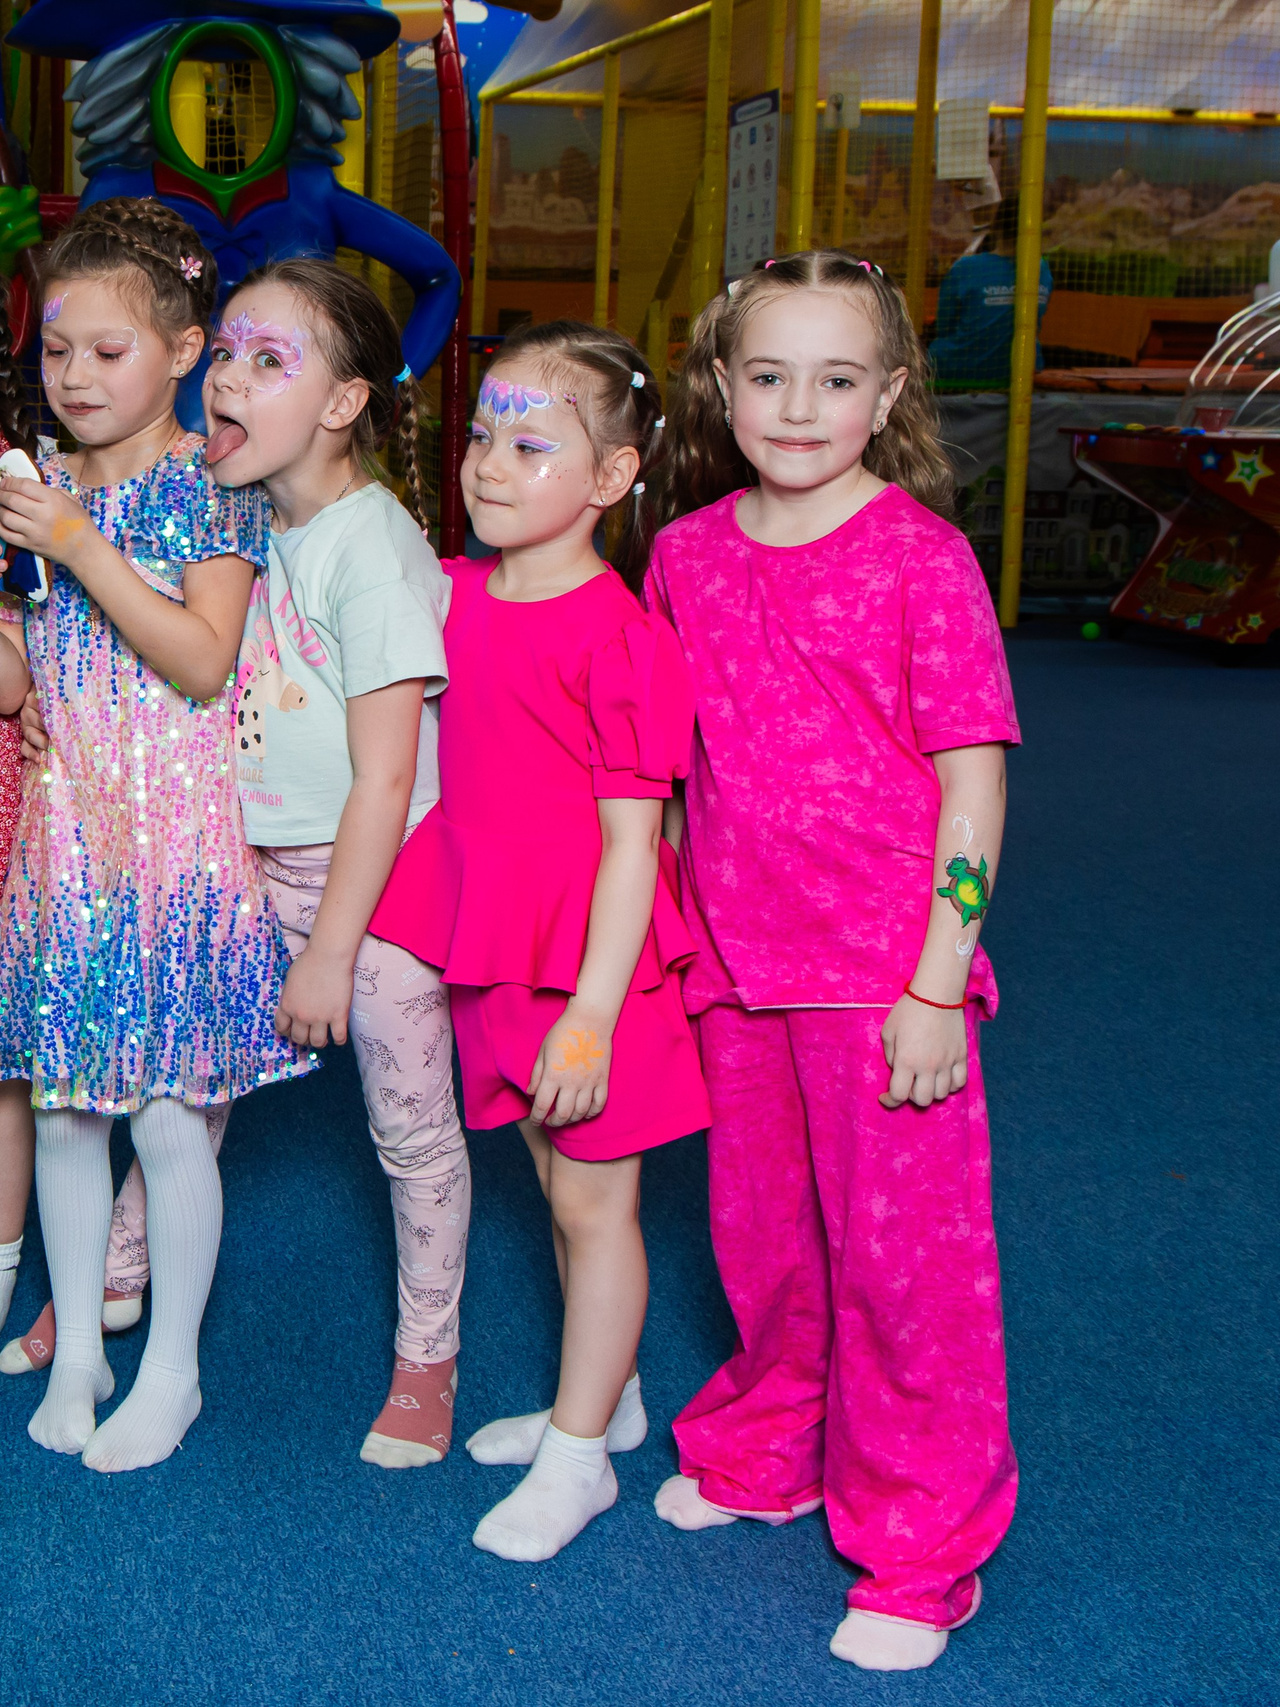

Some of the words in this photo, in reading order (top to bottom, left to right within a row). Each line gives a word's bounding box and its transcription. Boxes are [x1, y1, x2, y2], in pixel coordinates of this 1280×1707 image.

[274, 587, 328, 667] KIND
[239, 766, 264, 784] MORE
[241, 788, 283, 807] ENOUGH
[401, 966, 417, 980] BEST
